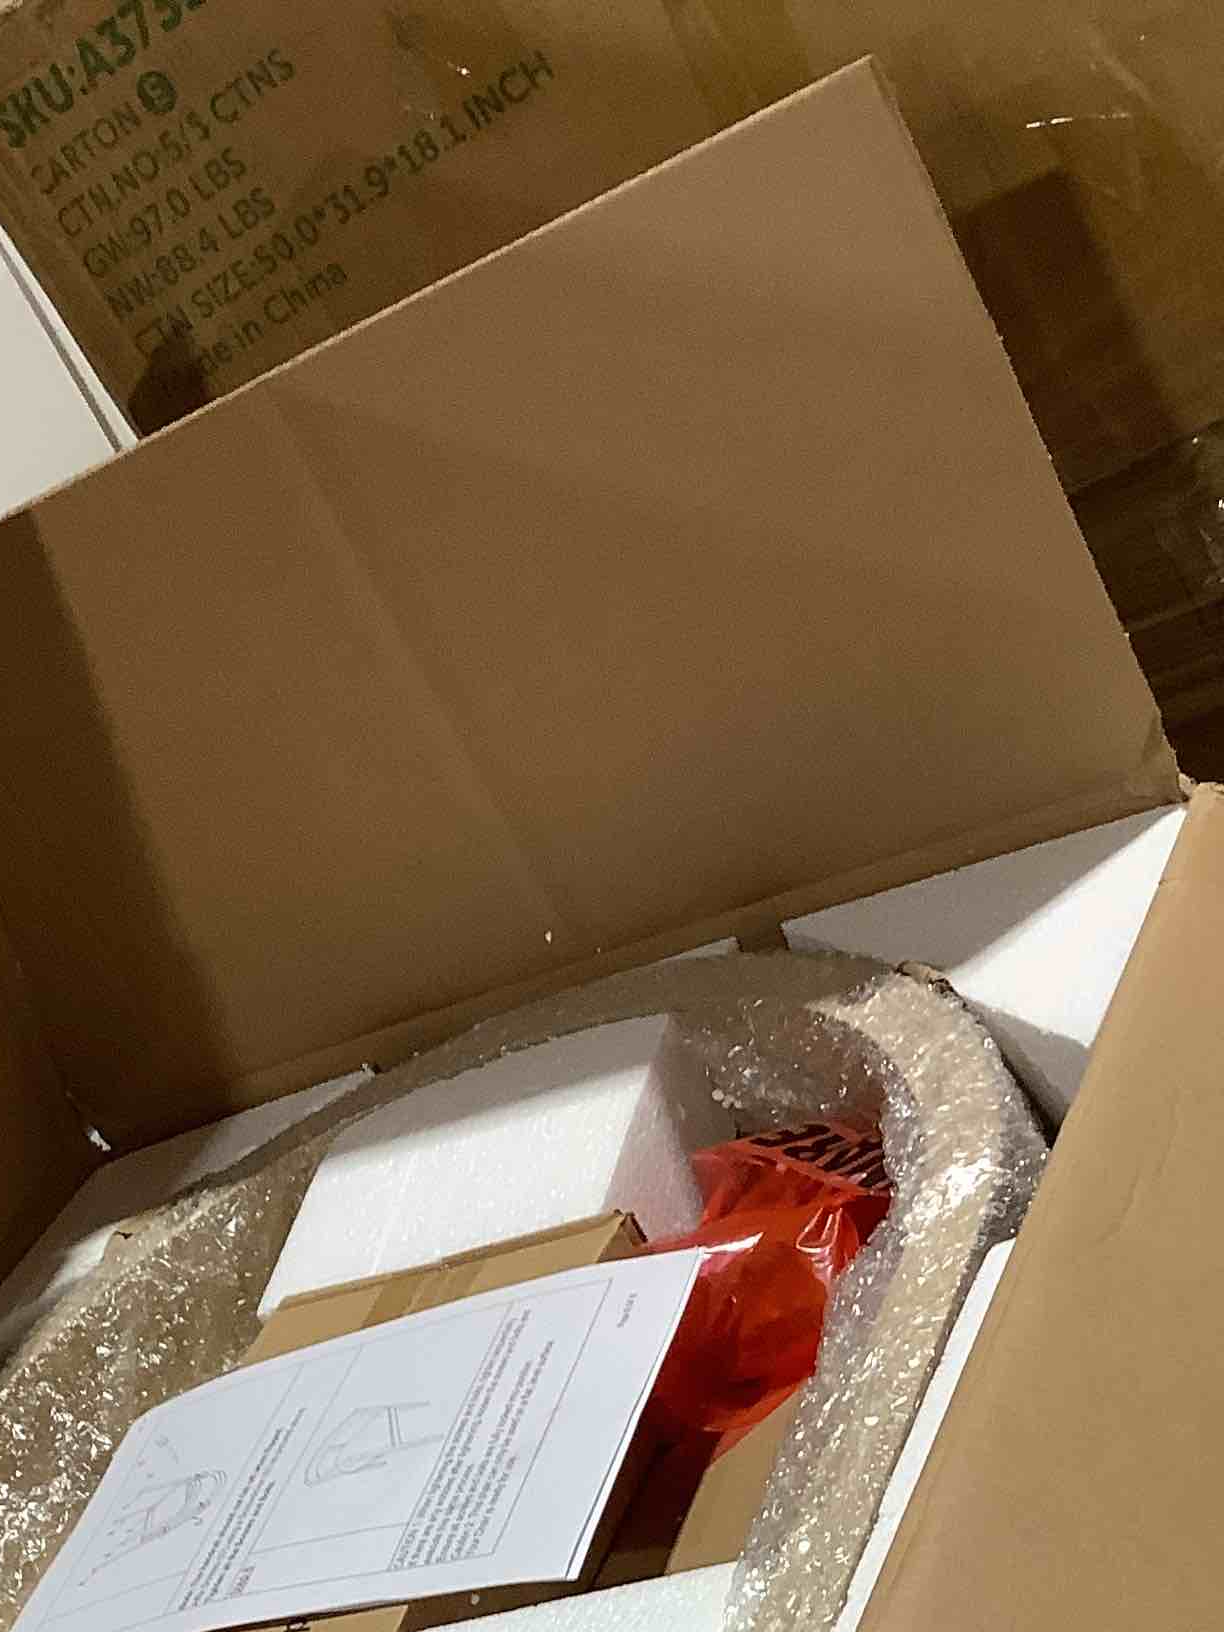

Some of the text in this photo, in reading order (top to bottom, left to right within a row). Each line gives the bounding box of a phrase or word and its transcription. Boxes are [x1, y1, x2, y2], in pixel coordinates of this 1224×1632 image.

[209, 48, 295, 124] CTNS
[188, 146, 247, 201] LBS
[217, 187, 275, 239] LBS
[263, 262, 348, 324] China
